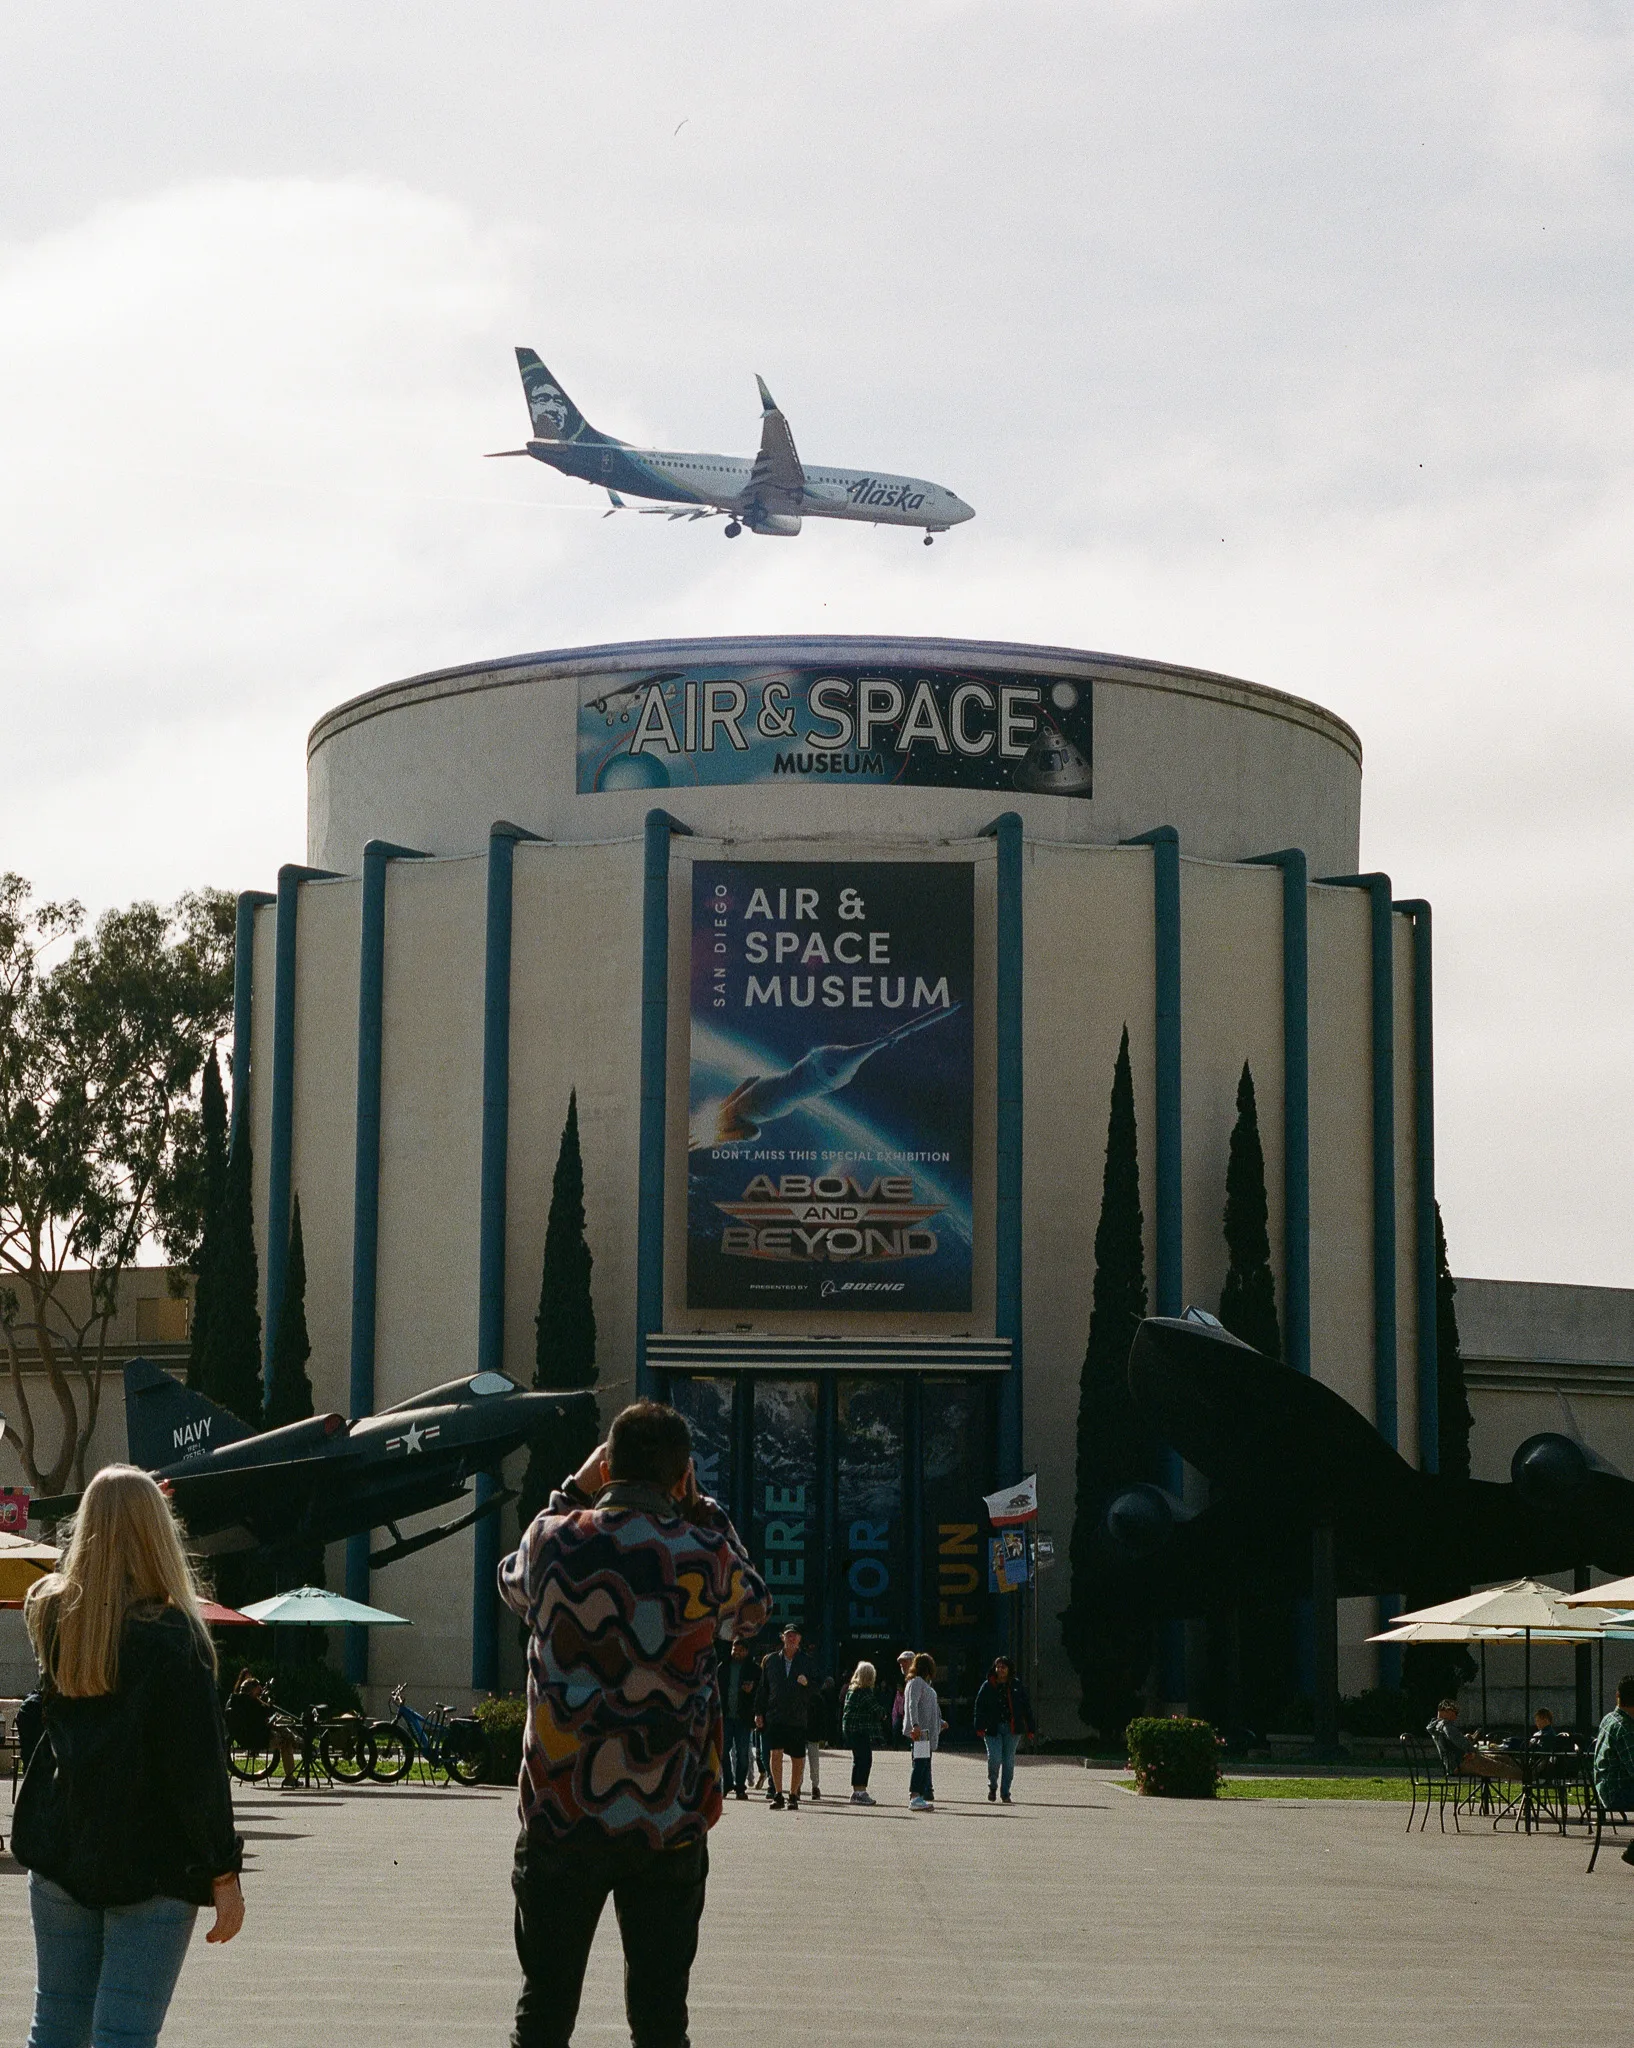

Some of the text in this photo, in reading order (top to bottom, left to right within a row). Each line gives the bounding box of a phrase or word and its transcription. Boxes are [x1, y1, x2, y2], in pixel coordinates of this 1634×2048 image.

[847, 478, 925, 511] Alaska
[628, 677, 1041, 759] AIR & SPACE
[772, 751, 885, 775] MUSEUM
[744, 888, 866, 920] AIR &
[713, 884, 727, 1008] SAN DIEGO
[745, 931, 890, 964] SPACE
[744, 974, 950, 1008] MUSEUM
[754, 1150, 786, 1162] MISS
[789, 1150, 818, 1162] THIS
[820, 1151, 873, 1162] SPECIAL
[876, 1151, 950, 1163] EXHIBITION
[741, 1174, 913, 1200] ABOVE
[802, 1206, 859, 1221] AND
[721, 1227, 938, 1257] BEYOND
[841, 1282, 905, 1292] BOEING
[173, 1416, 211, 1448] NAVY
[765, 1485, 804, 1625] HERE
[848, 1520, 889, 1626] FOR
[937, 1522, 979, 1626] FUN
